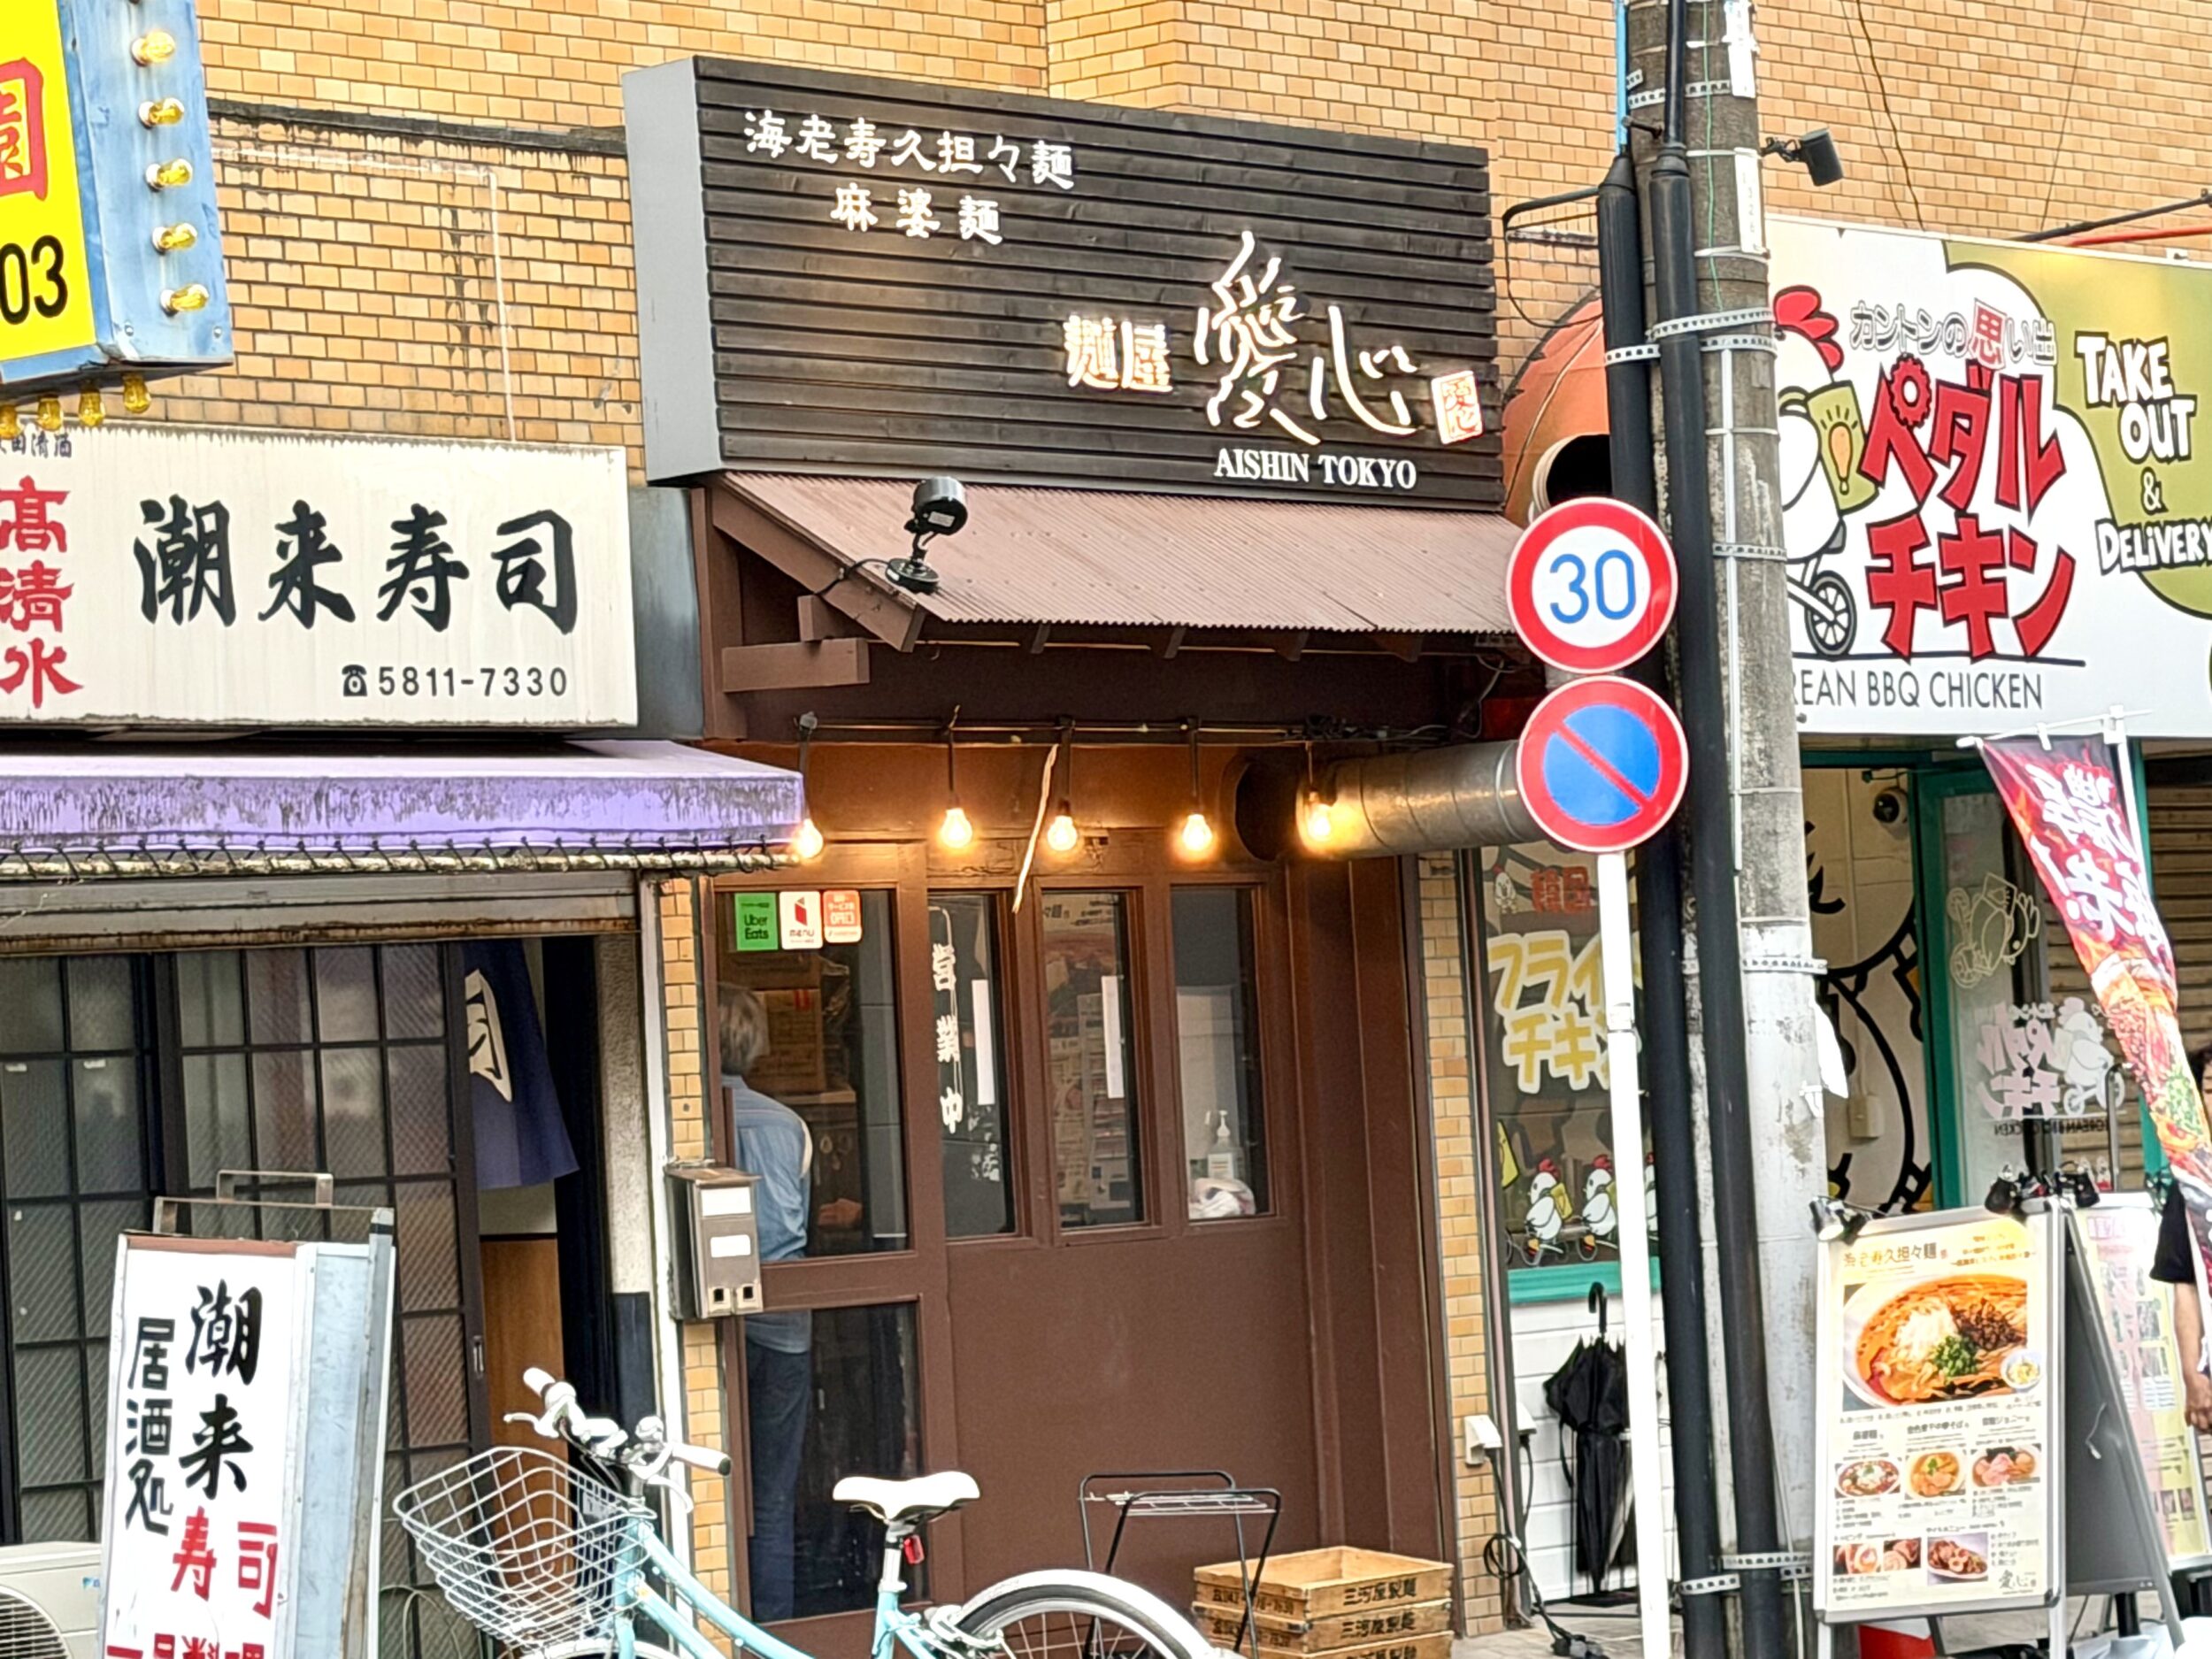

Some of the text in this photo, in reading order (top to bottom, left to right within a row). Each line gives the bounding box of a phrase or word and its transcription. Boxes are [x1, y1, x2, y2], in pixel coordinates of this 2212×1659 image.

[744, 110, 1074, 190] 海老寿久担々麺
[830, 182, 1002, 245] 麻婆麺
[1849, 299, 2058, 370] カントンの思い出
[2074, 330, 2176, 409] TAKE
[0, 430, 73, 458] 田清酒
[1857, 357, 2067, 527] ペダル
[2117, 394, 2198, 465] OUT
[1214, 448, 1417, 489] AISHIN TOKYO
[2140, 466, 2170, 515] &
[134, 494, 578, 635] 潮来寿司
[1549, 549, 1637, 624] 30
[1865, 511, 2077, 664] チキン
[378, 666, 567, 697] 5811-7330
[1792, 669, 2043, 710] EAN BBQ CHICKEN
[744, 914, 768, 926] Uber
[745, 927, 769, 940] Eats
[1487, 931, 1642, 1010] フライ
[1503, 1004, 1612, 1094] チキ
[179, 1279, 263, 1500] 潮来
[125, 1317, 175, 1536] 居酒処
[171, 1505, 278, 1619] 寿司
[1343, 1577, 1417, 1607] 三河屋製麺
